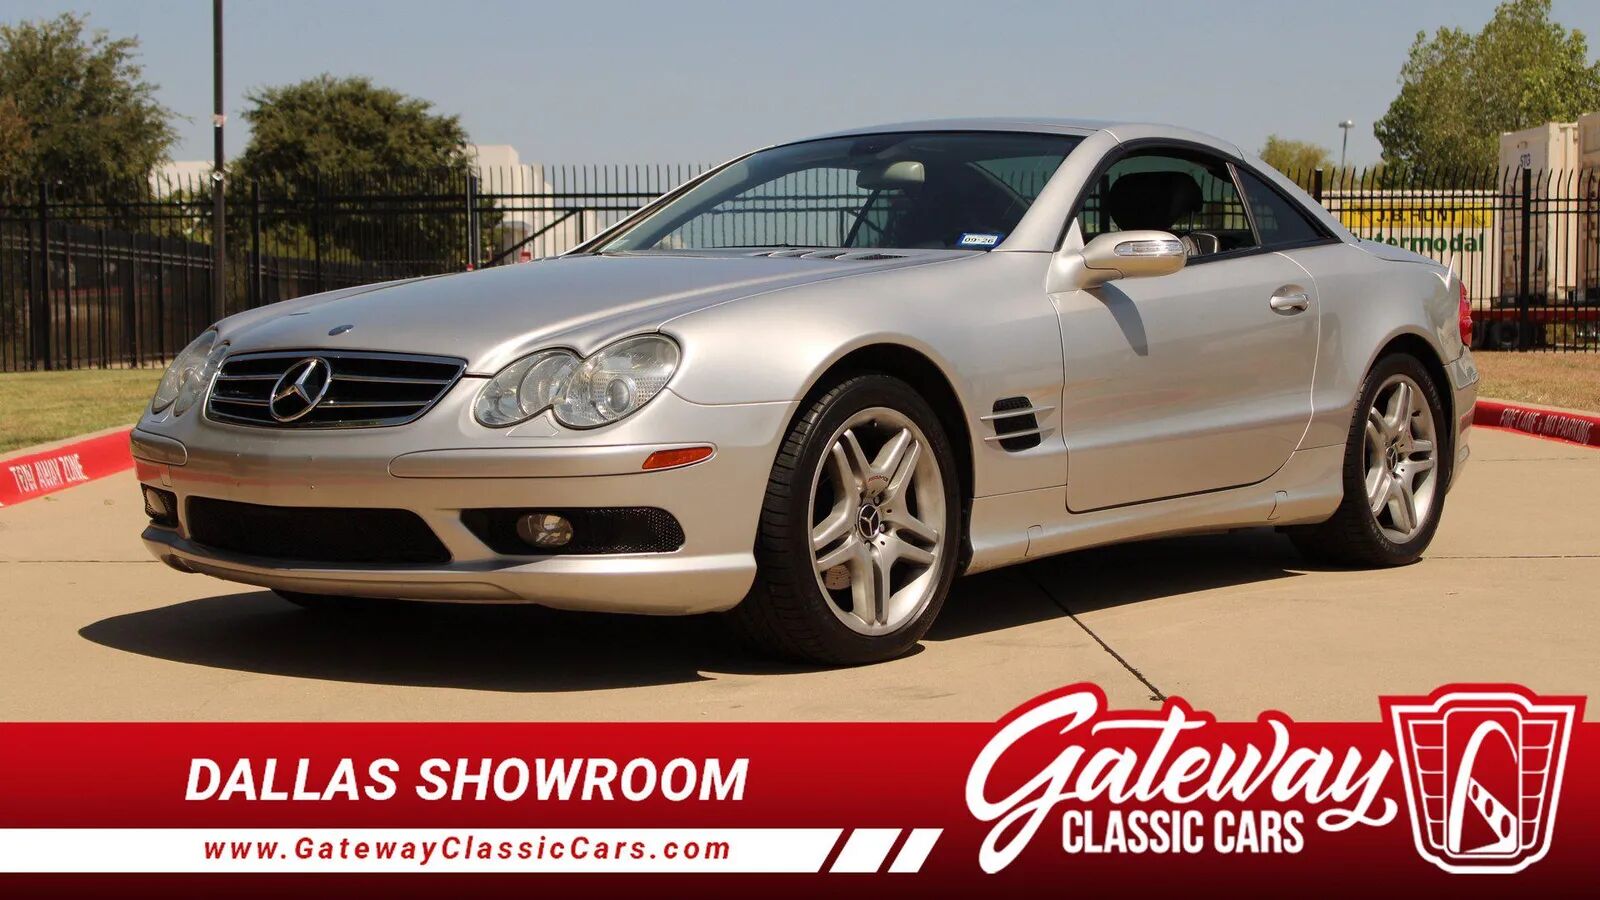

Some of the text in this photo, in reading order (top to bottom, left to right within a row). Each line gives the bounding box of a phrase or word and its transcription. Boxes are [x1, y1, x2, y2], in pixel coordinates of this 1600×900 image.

[1411, 208, 1456, 222] HUNT
[1354, 231, 1483, 252] termodal
[1500, 408, 1520, 428] FIRE
[1515, 410, 1540, 433] LANE
[1543, 414, 1558, 433] NO
[1555, 416, 1594, 444] PARKING
[9, 453, 88, 494] TOW AWAY ZONE
